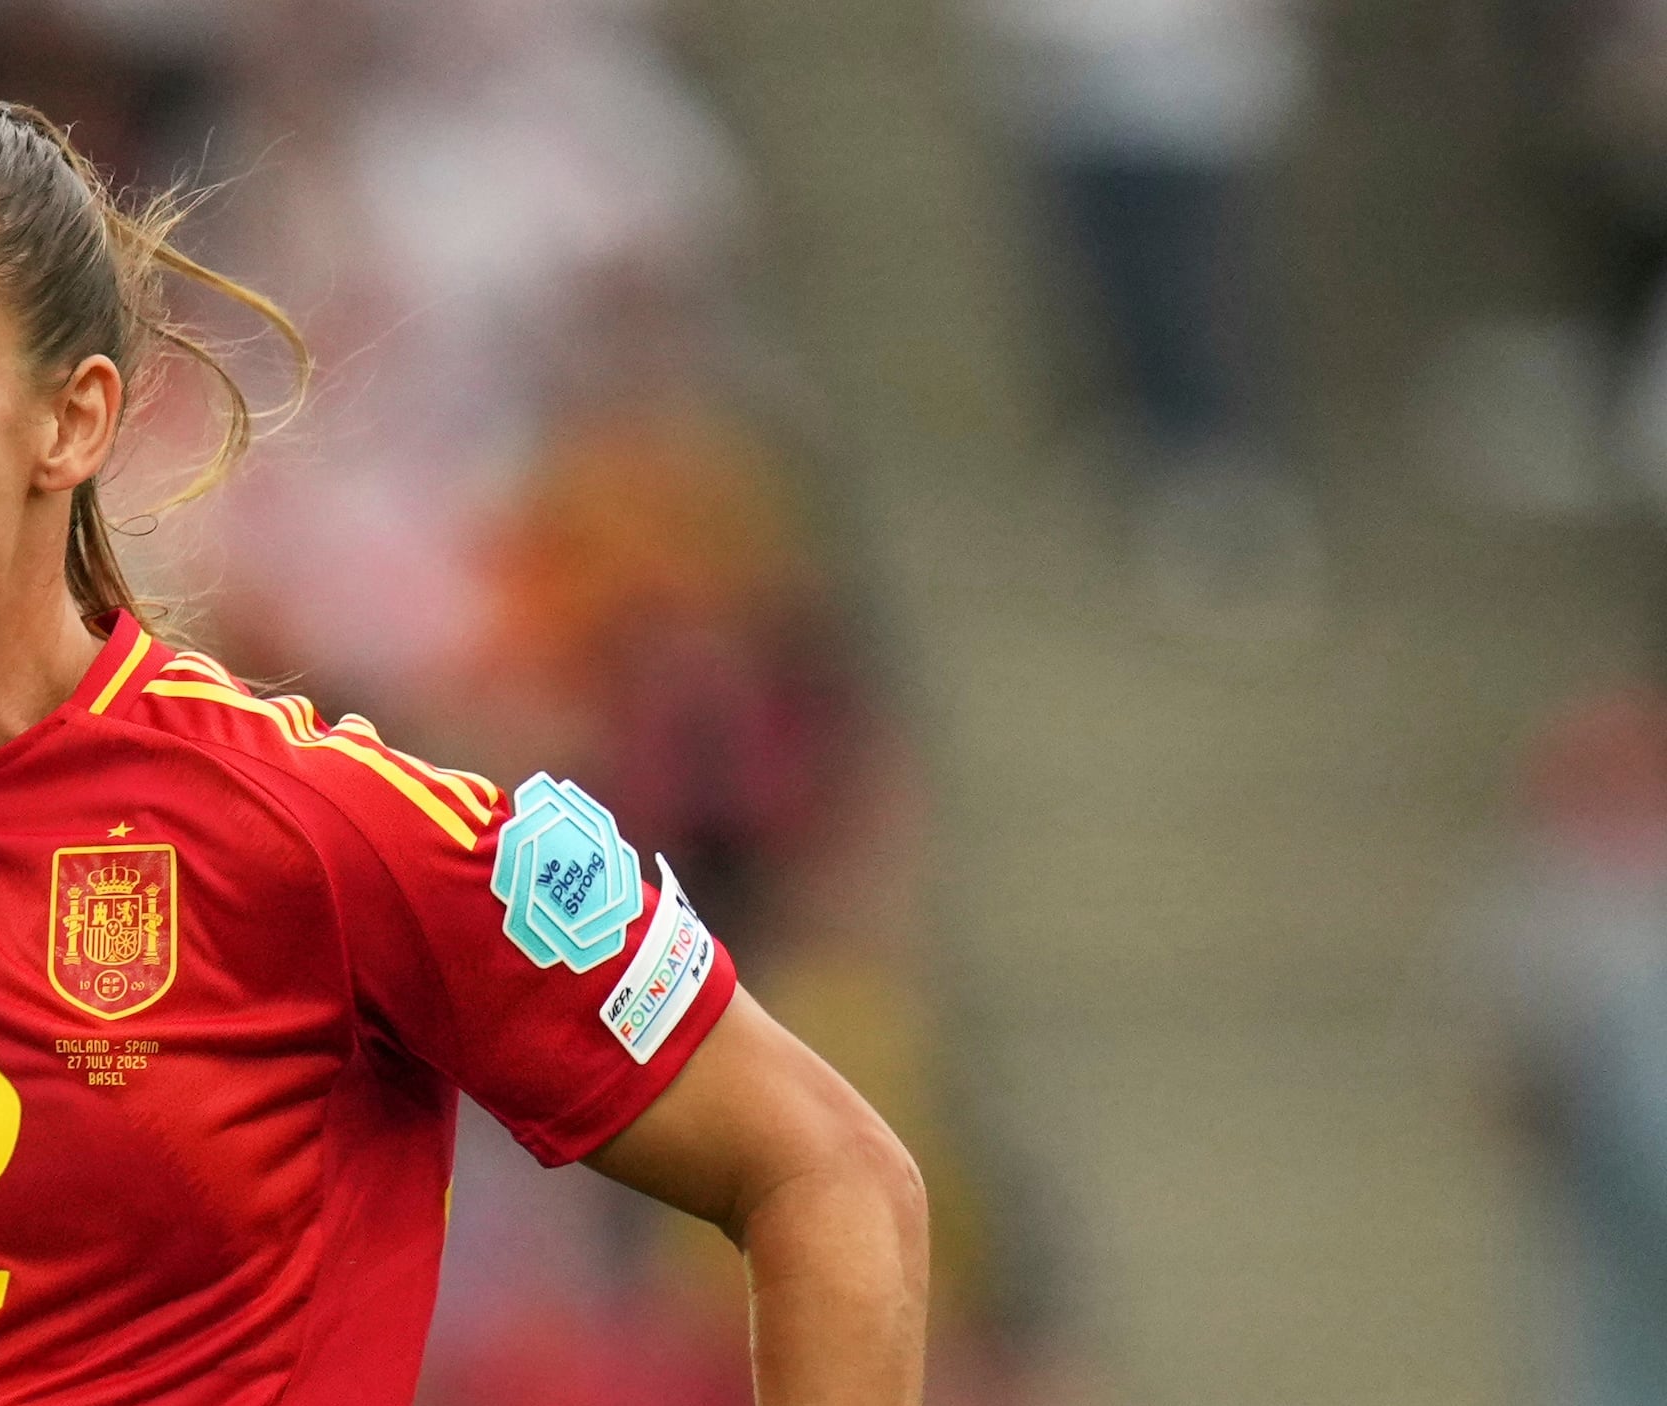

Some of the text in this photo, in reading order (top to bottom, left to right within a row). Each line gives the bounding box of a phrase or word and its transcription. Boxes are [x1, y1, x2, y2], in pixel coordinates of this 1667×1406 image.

[537, 859, 561, 883] We
[551, 860, 583, 903] Play
[565, 852, 605, 915] Strong
[620, 916, 695, 1042] FOUNDATION
[607, 986, 634, 1023] UEFA
[55, 1039, 110, 1054] ENGLAND
[124, 1040, 160, 1054] SPAIN
[67, 1055, 148, 1069] 27 JULY 2025
[88, 1071, 127, 1086] BASEL
